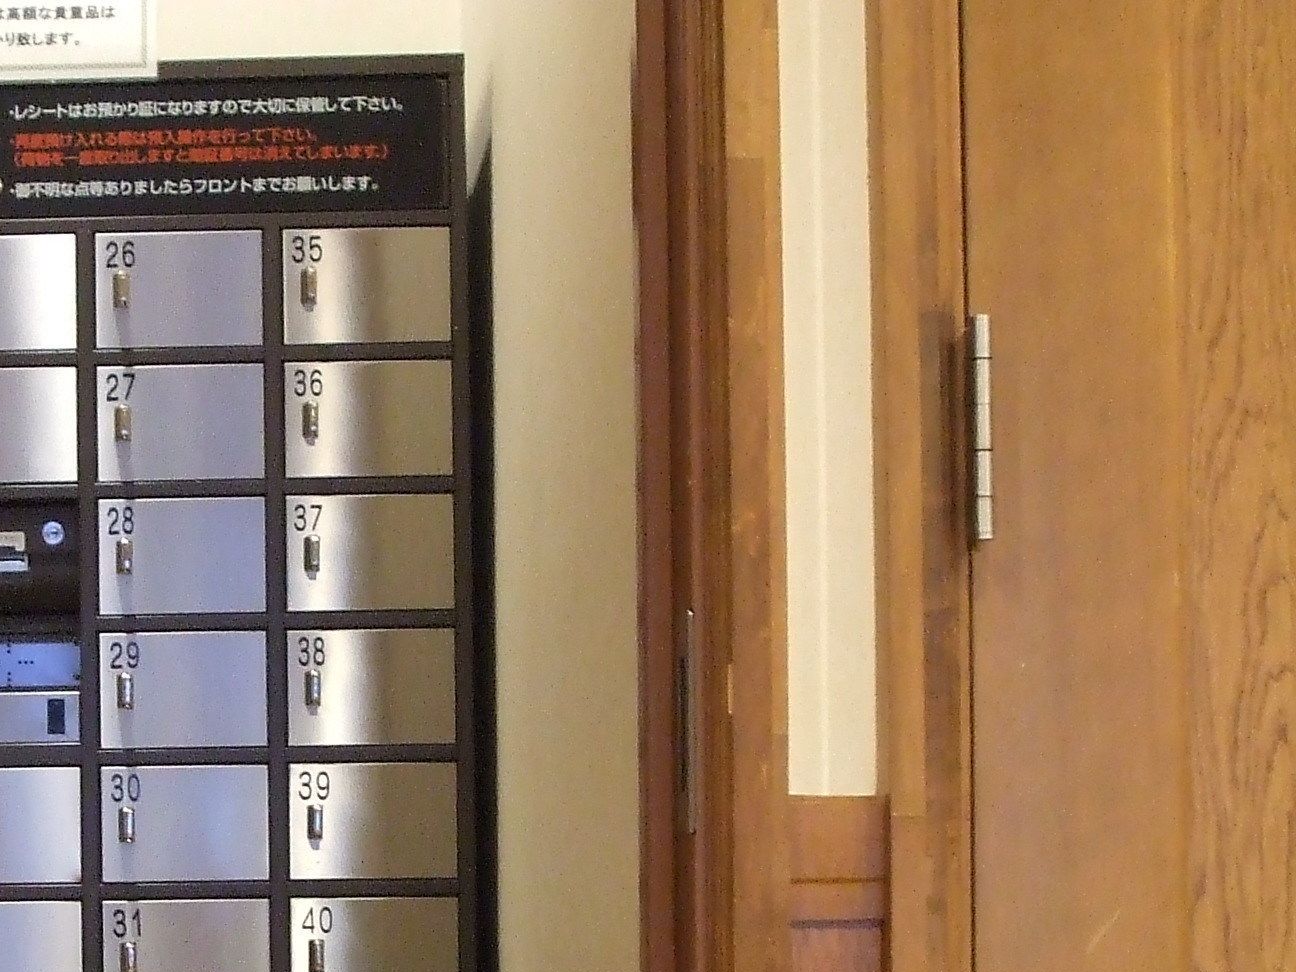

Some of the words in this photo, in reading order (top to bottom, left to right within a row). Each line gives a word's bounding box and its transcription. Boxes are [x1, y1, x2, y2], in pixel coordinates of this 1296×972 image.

[106, 241, 134, 269] 26
[292, 236, 322, 263] 35
[106, 373, 135, 402] 27
[294, 370, 323, 397] 36
[107, 507, 134, 535] 28
[294, 504, 322, 531] 37
[110, 642, 138, 669] 29
[297, 638, 325, 665] 38
[111, 774, 141, 802] 30
[299, 771, 330, 799] 39
[113, 909, 142, 937] 31
[302, 907, 333, 934] 40
